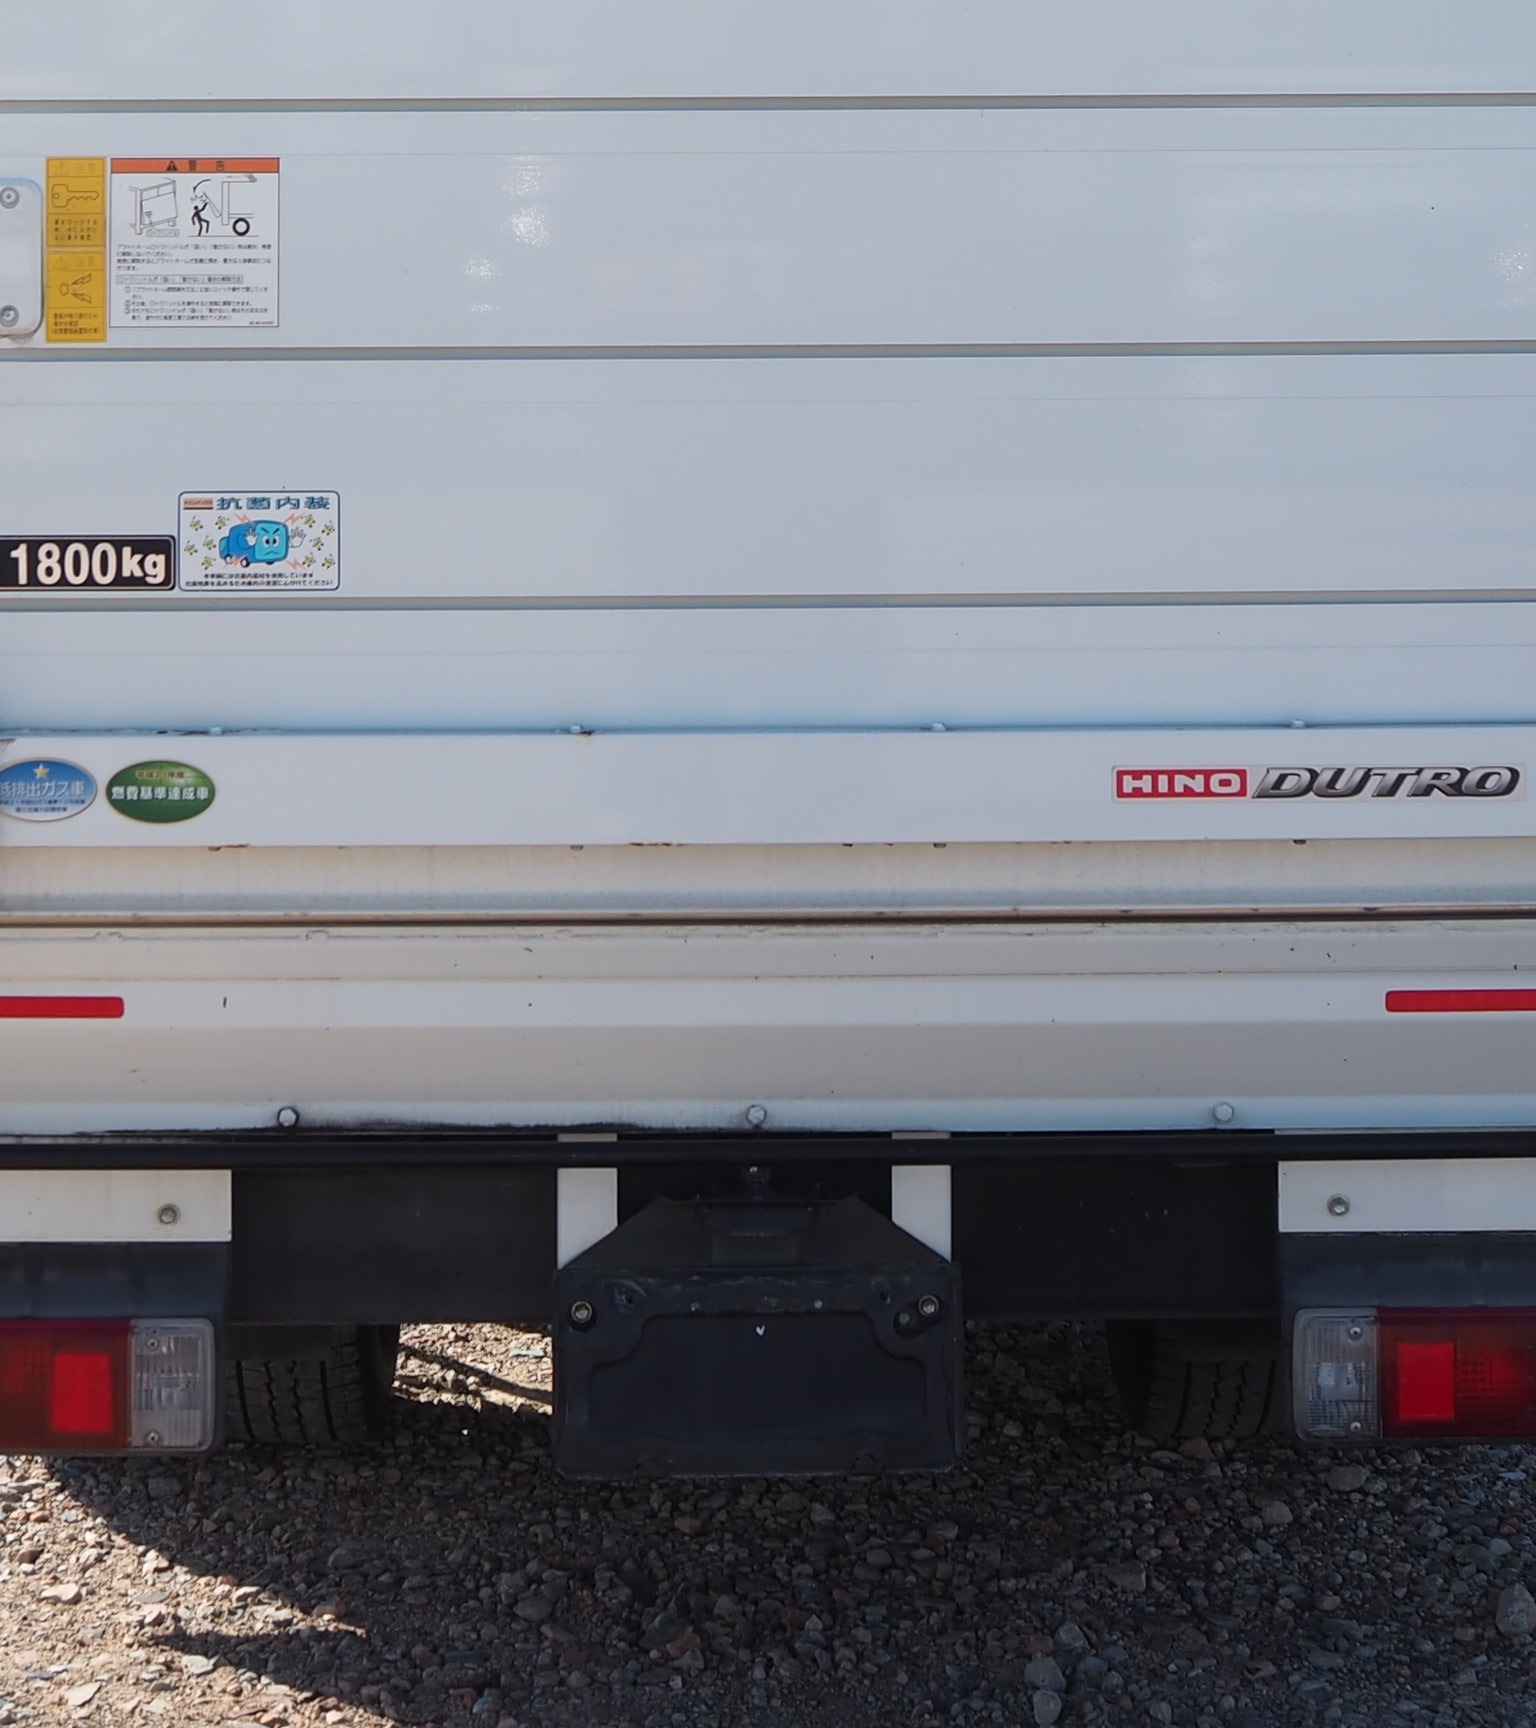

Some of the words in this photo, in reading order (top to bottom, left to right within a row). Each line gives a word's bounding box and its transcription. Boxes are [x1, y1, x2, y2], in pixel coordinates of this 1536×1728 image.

[216, 496, 330, 510] 抗菌内装
[9, 541, 166, 585] 1800kg
[111, 785, 209, 801] 燃費基準達成車
[1122, 773, 1242, 794] HINO
[1251, 766, 1521, 800] DUTRO
